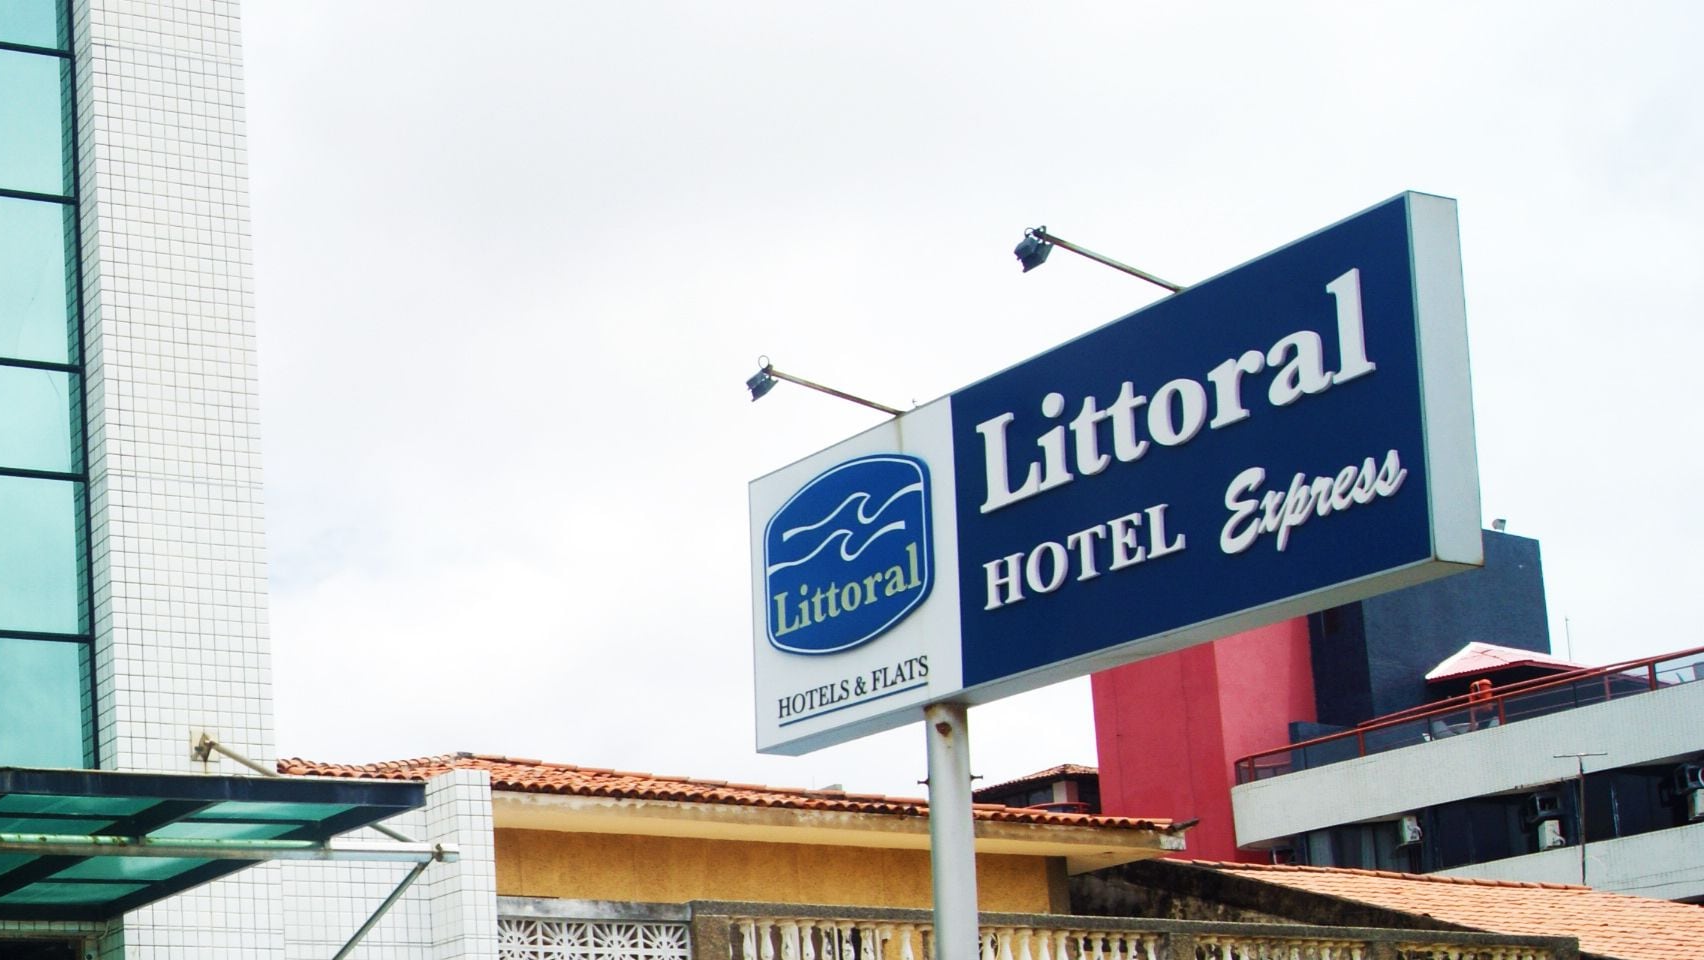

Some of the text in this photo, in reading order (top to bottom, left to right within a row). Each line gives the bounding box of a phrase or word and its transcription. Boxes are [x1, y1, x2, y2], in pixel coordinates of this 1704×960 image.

[976, 268, 1376, 514] Littoral
[774, 541, 921, 637] Littoral
[983, 449, 1407, 611] HOTEL Express
[778, 655, 929, 719] HOTELS & FLATS
